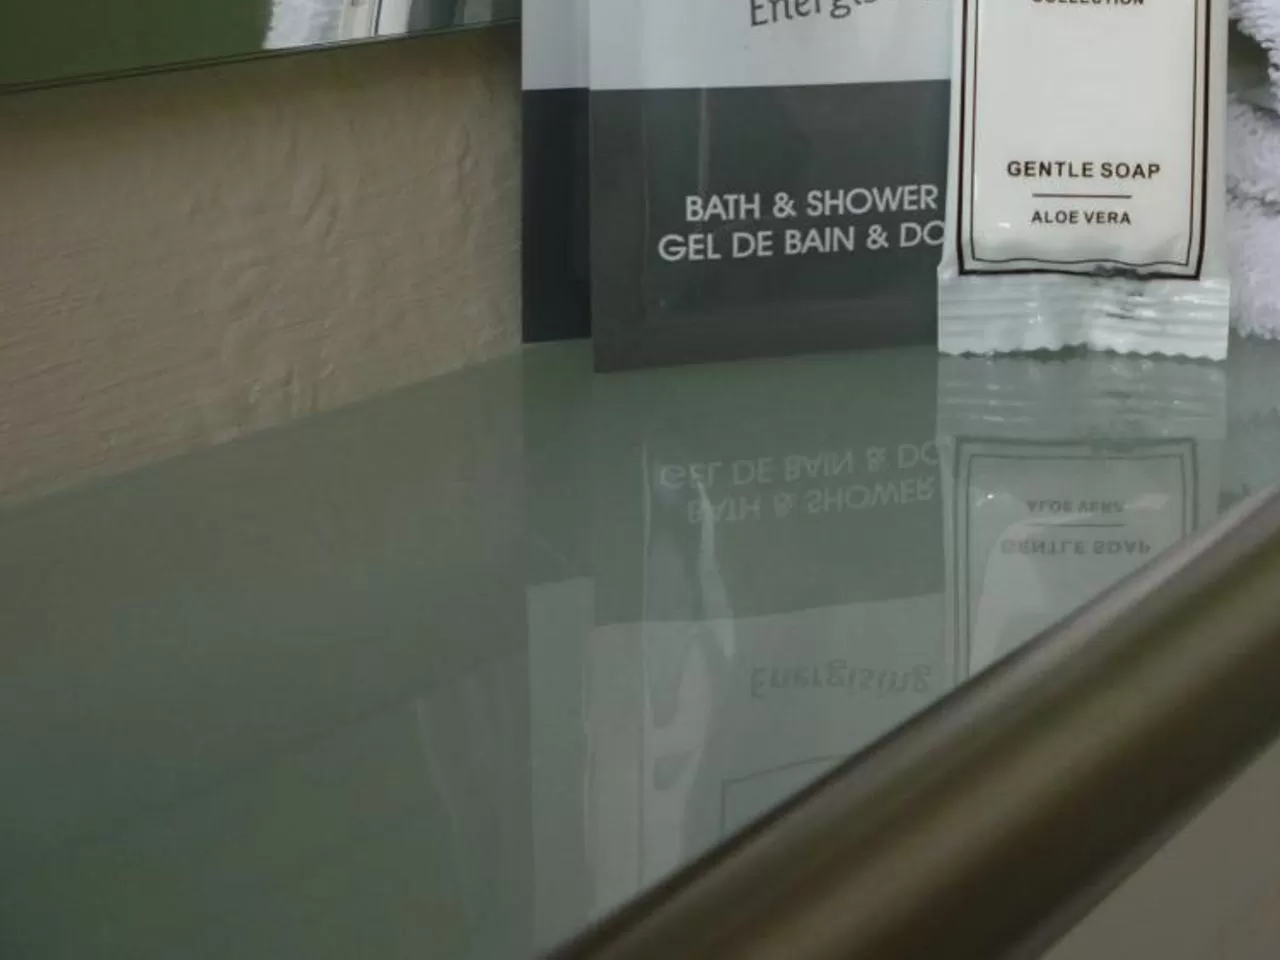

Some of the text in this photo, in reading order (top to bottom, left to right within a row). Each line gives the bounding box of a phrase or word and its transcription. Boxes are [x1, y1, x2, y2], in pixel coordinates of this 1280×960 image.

[1007, 161, 1161, 179] GENTLE SOAP
[686, 184, 939, 221] BATH & SHOWER
[1031, 210, 1132, 225] ALOE VERA
[658, 234, 721, 261] GEL
[732, 231, 773, 258] DE
[785, 227, 854, 255] BAIN
[866, 225, 889, 249] &
